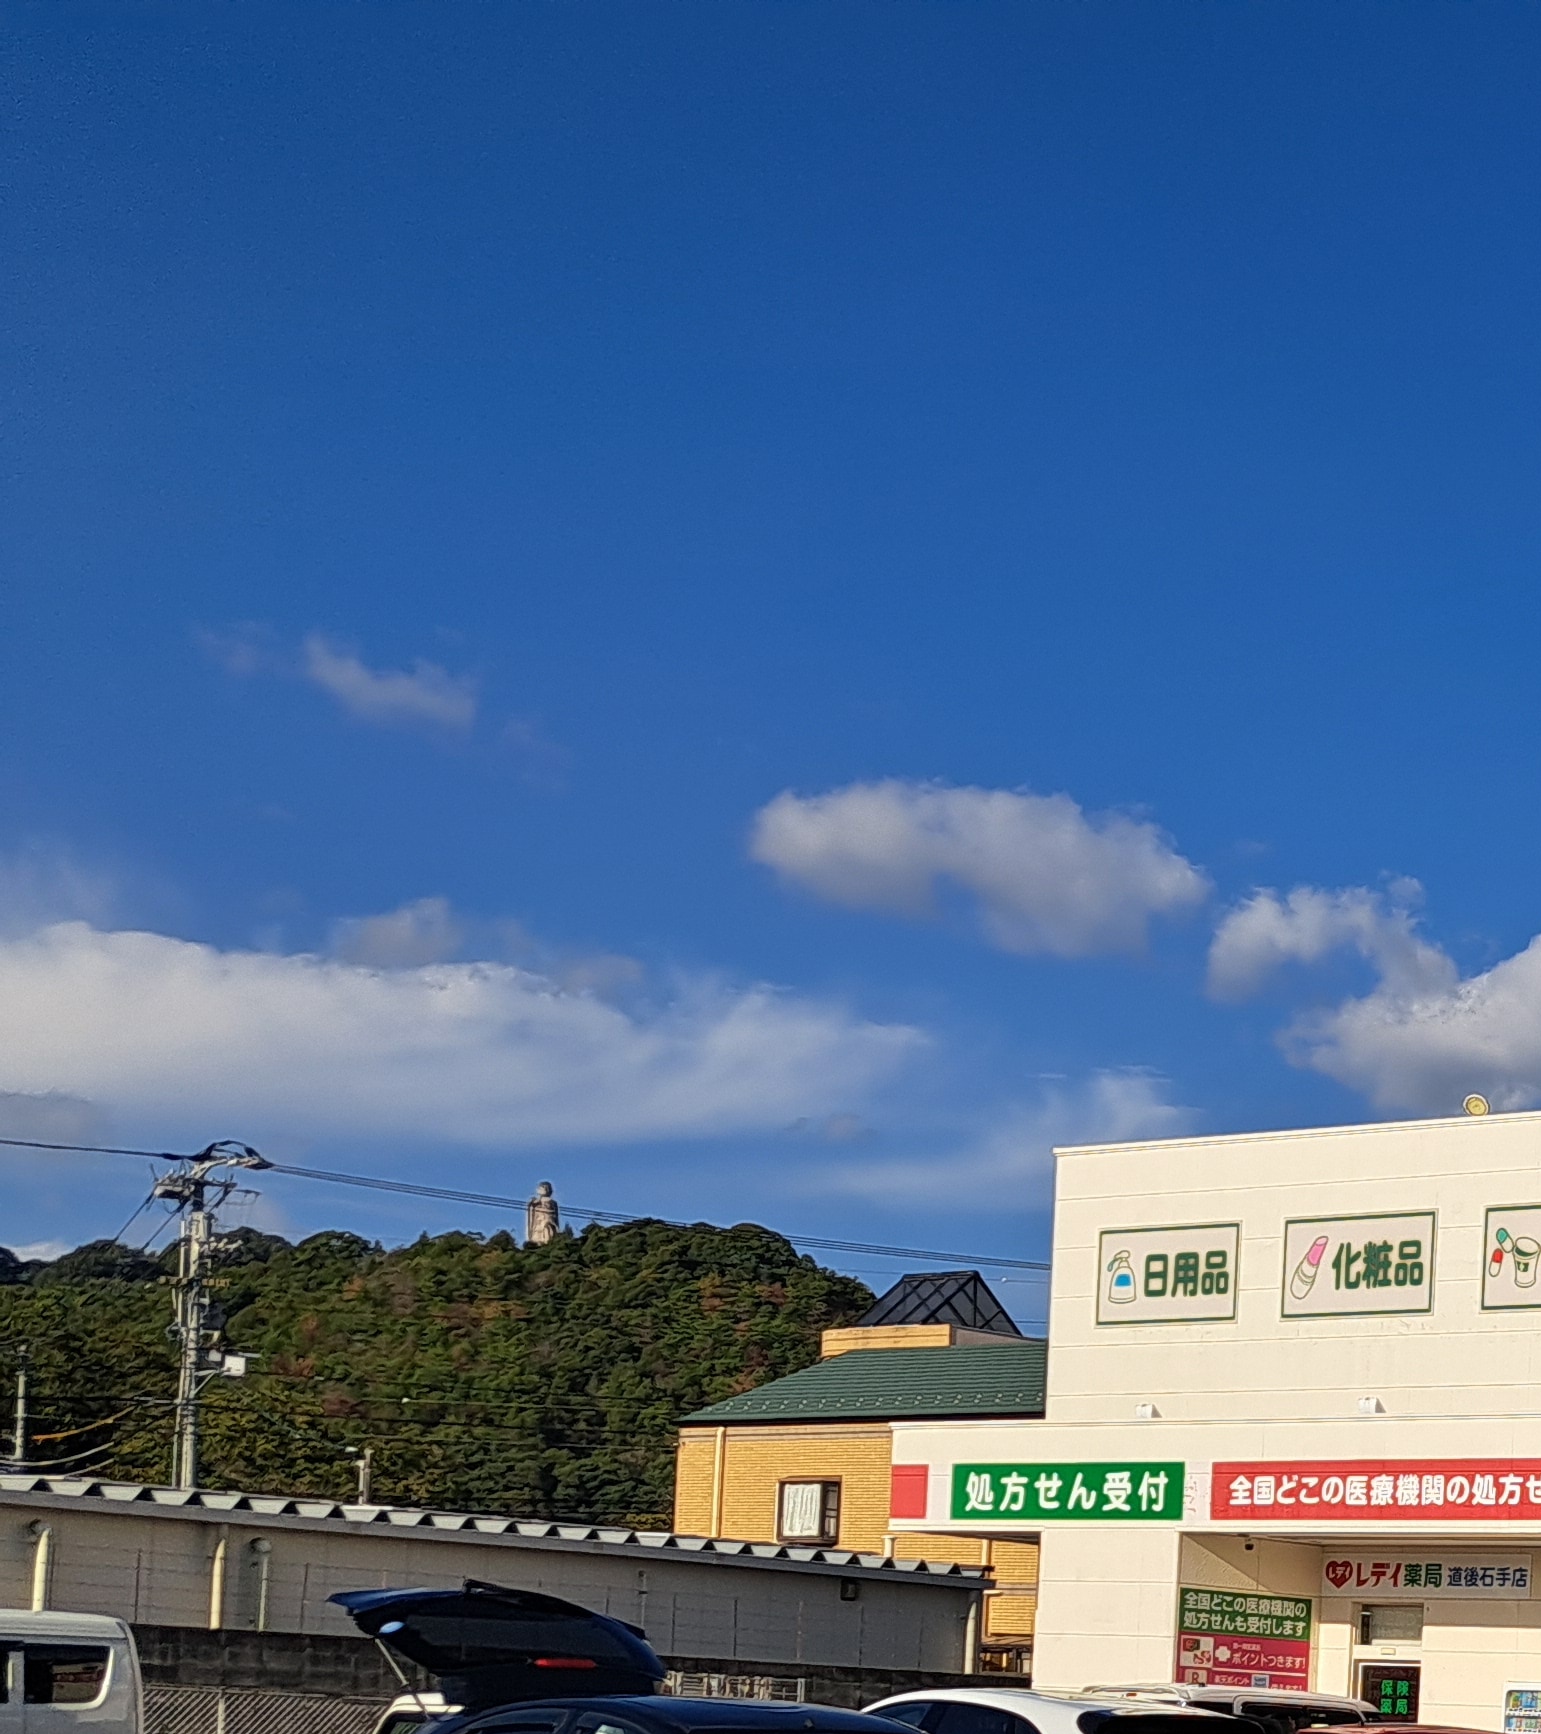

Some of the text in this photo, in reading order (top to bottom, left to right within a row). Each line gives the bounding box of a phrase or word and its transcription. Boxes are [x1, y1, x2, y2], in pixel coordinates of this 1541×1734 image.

[1143, 1249, 1230, 1299] 日用品
[1331, 1239, 1425, 1291] 化粧品
[964, 1470, 1170, 1513] 処方せん受付
[1329, 1562, 1528, 1588] レディ レディ薬局 道後石手店
[1184, 1592, 1307, 1618] 全国どこの医療機関の
[1183, 1611, 1306, 1637] 処方せんも受付します
[1381, 1679, 1410, 1697] 保険
